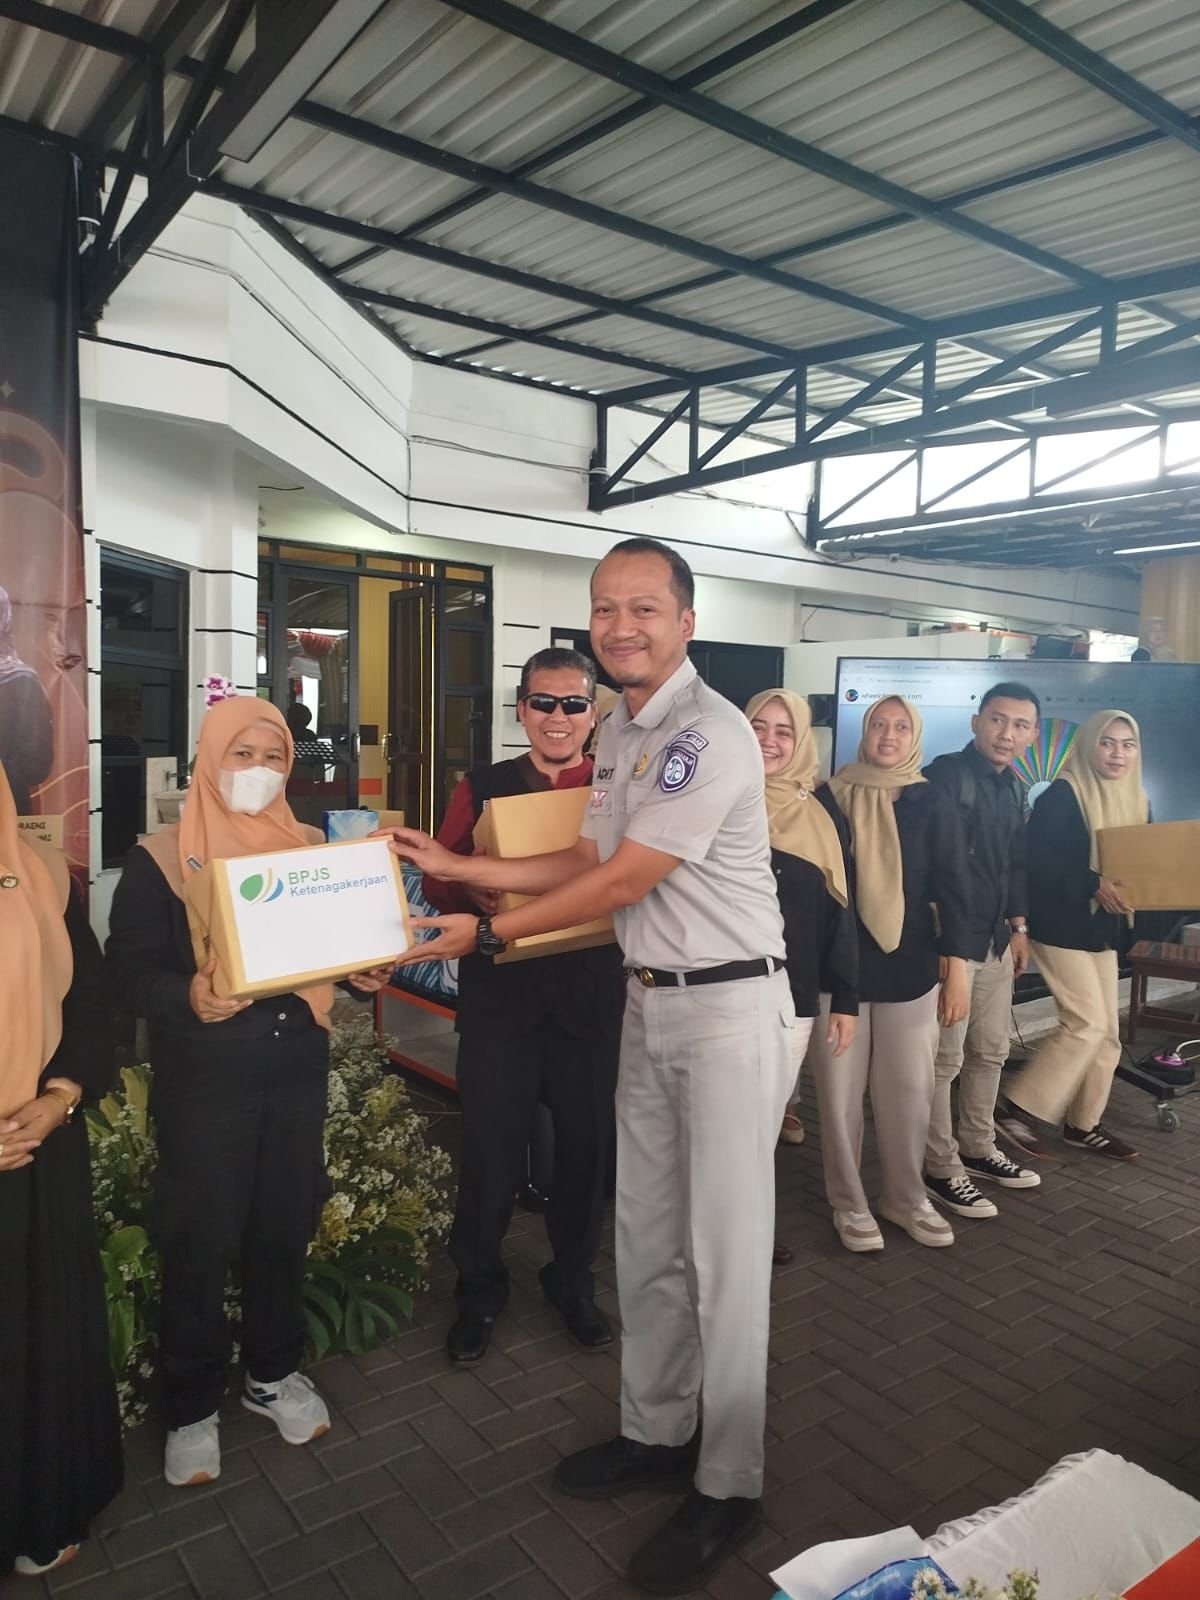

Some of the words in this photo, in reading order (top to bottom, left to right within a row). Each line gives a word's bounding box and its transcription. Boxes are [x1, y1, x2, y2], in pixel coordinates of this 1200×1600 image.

[17, 822, 46, 830] RAENI
[287, 867, 330, 885] BPJS
[289, 874, 388, 897] Ketenagakerjaan
